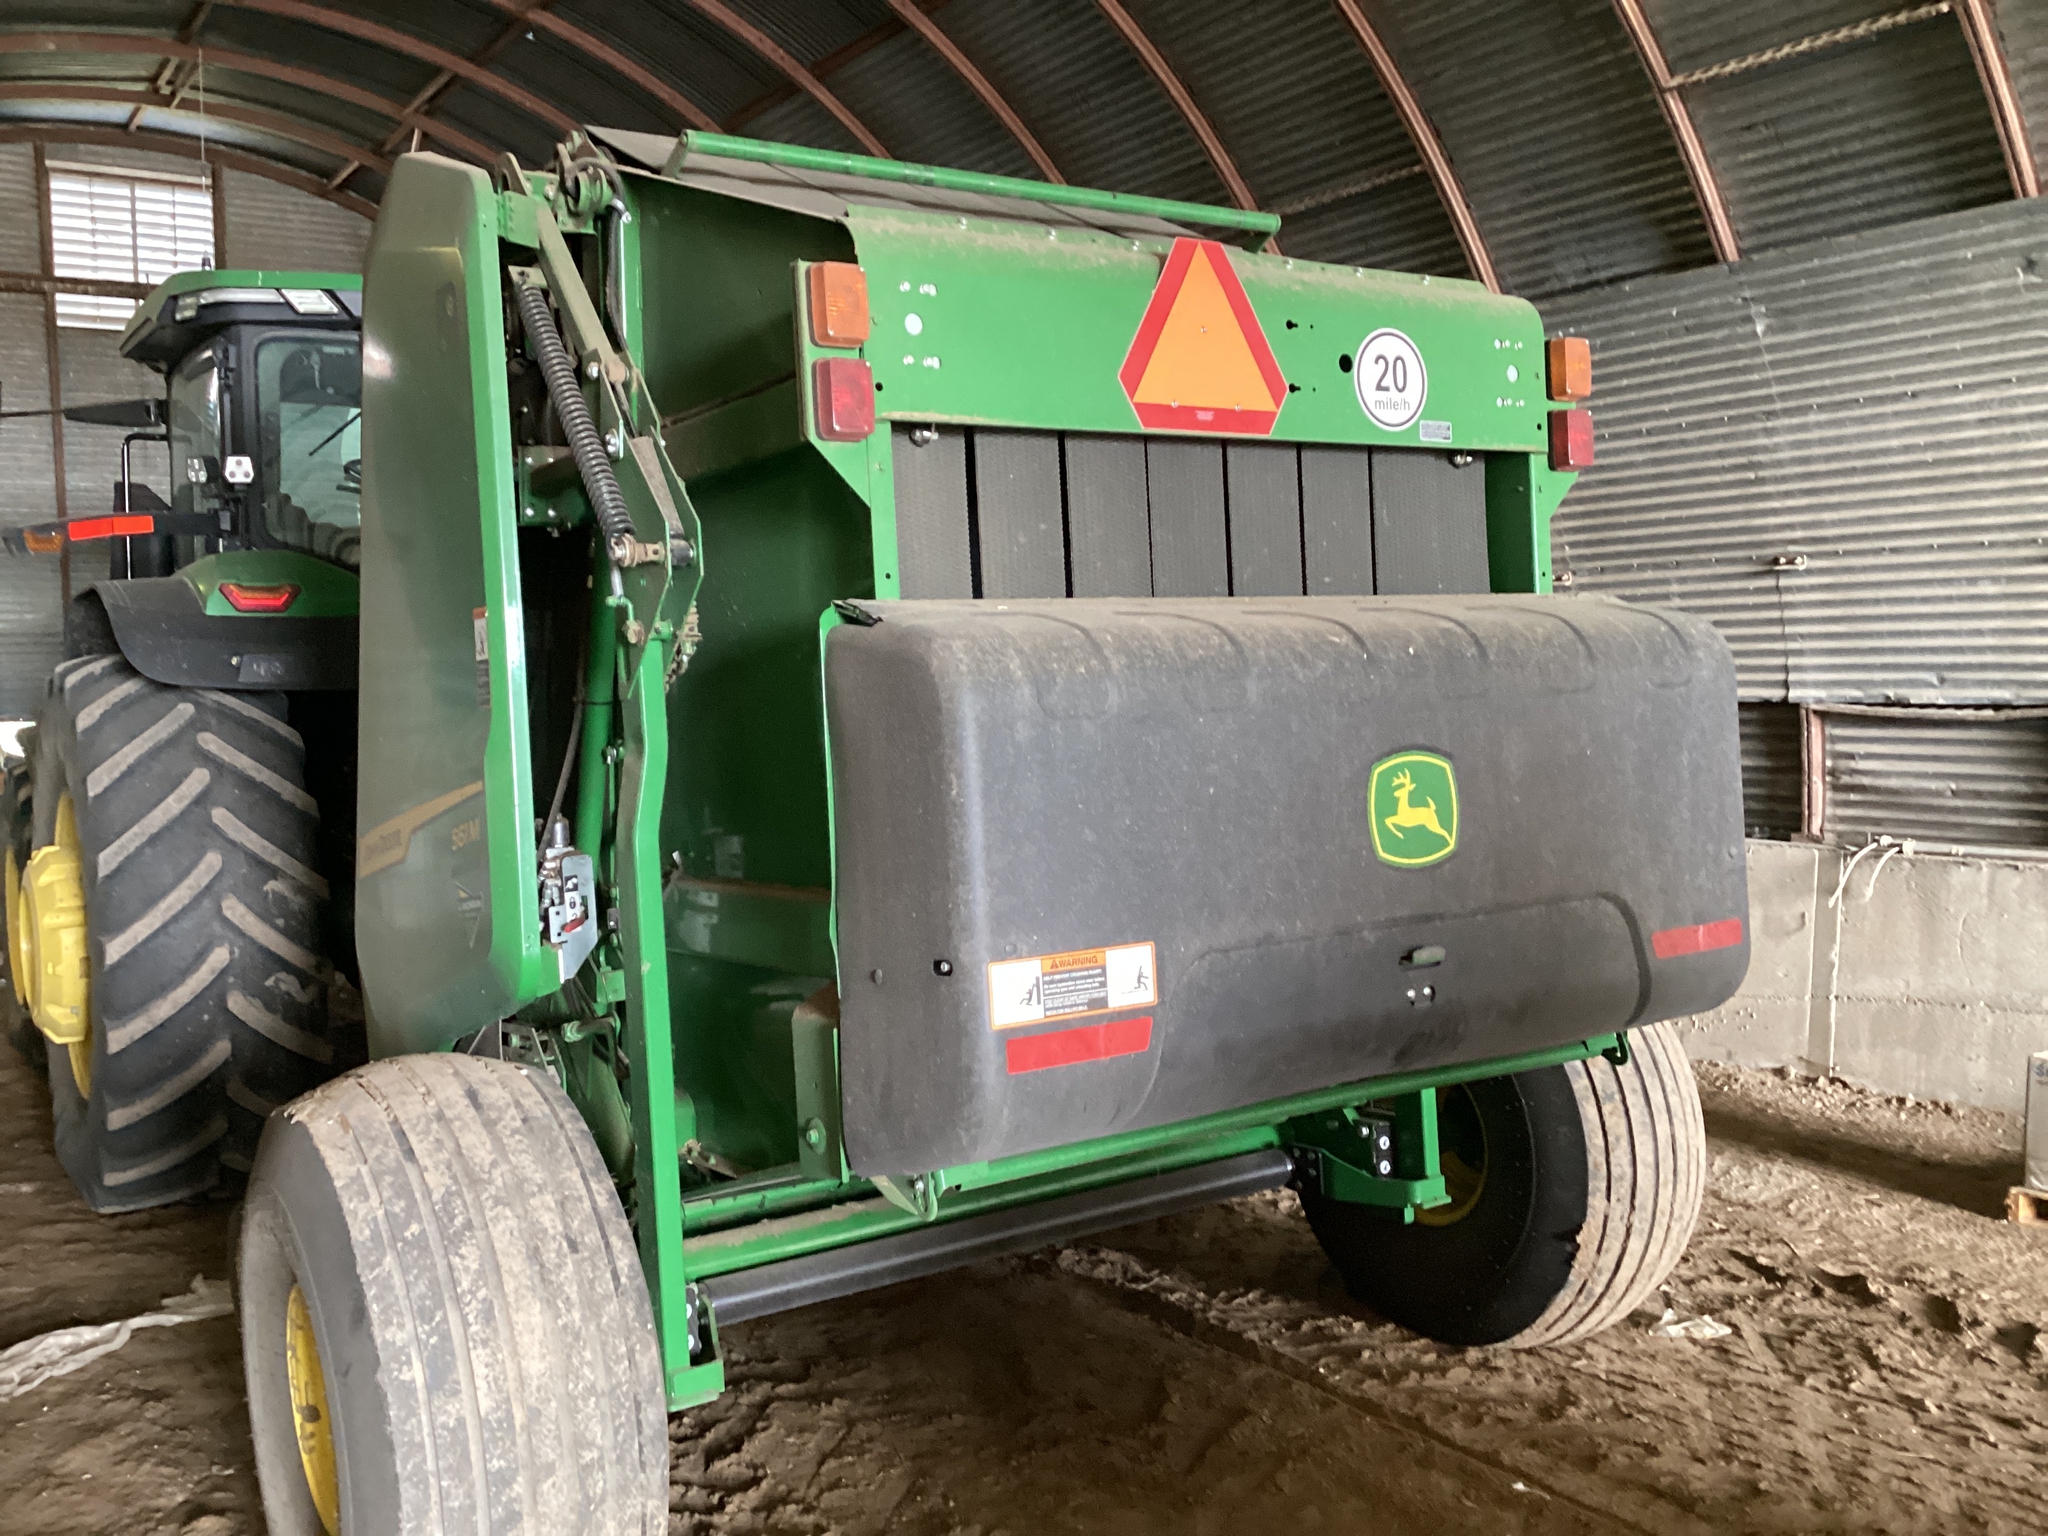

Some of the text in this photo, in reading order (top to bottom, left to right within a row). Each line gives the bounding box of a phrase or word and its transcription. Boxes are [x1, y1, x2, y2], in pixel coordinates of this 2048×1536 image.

[1374, 353, 1408, 394] 20
[1374, 397, 1411, 412] mile/h
[1058, 955, 1098, 968] WARNING
